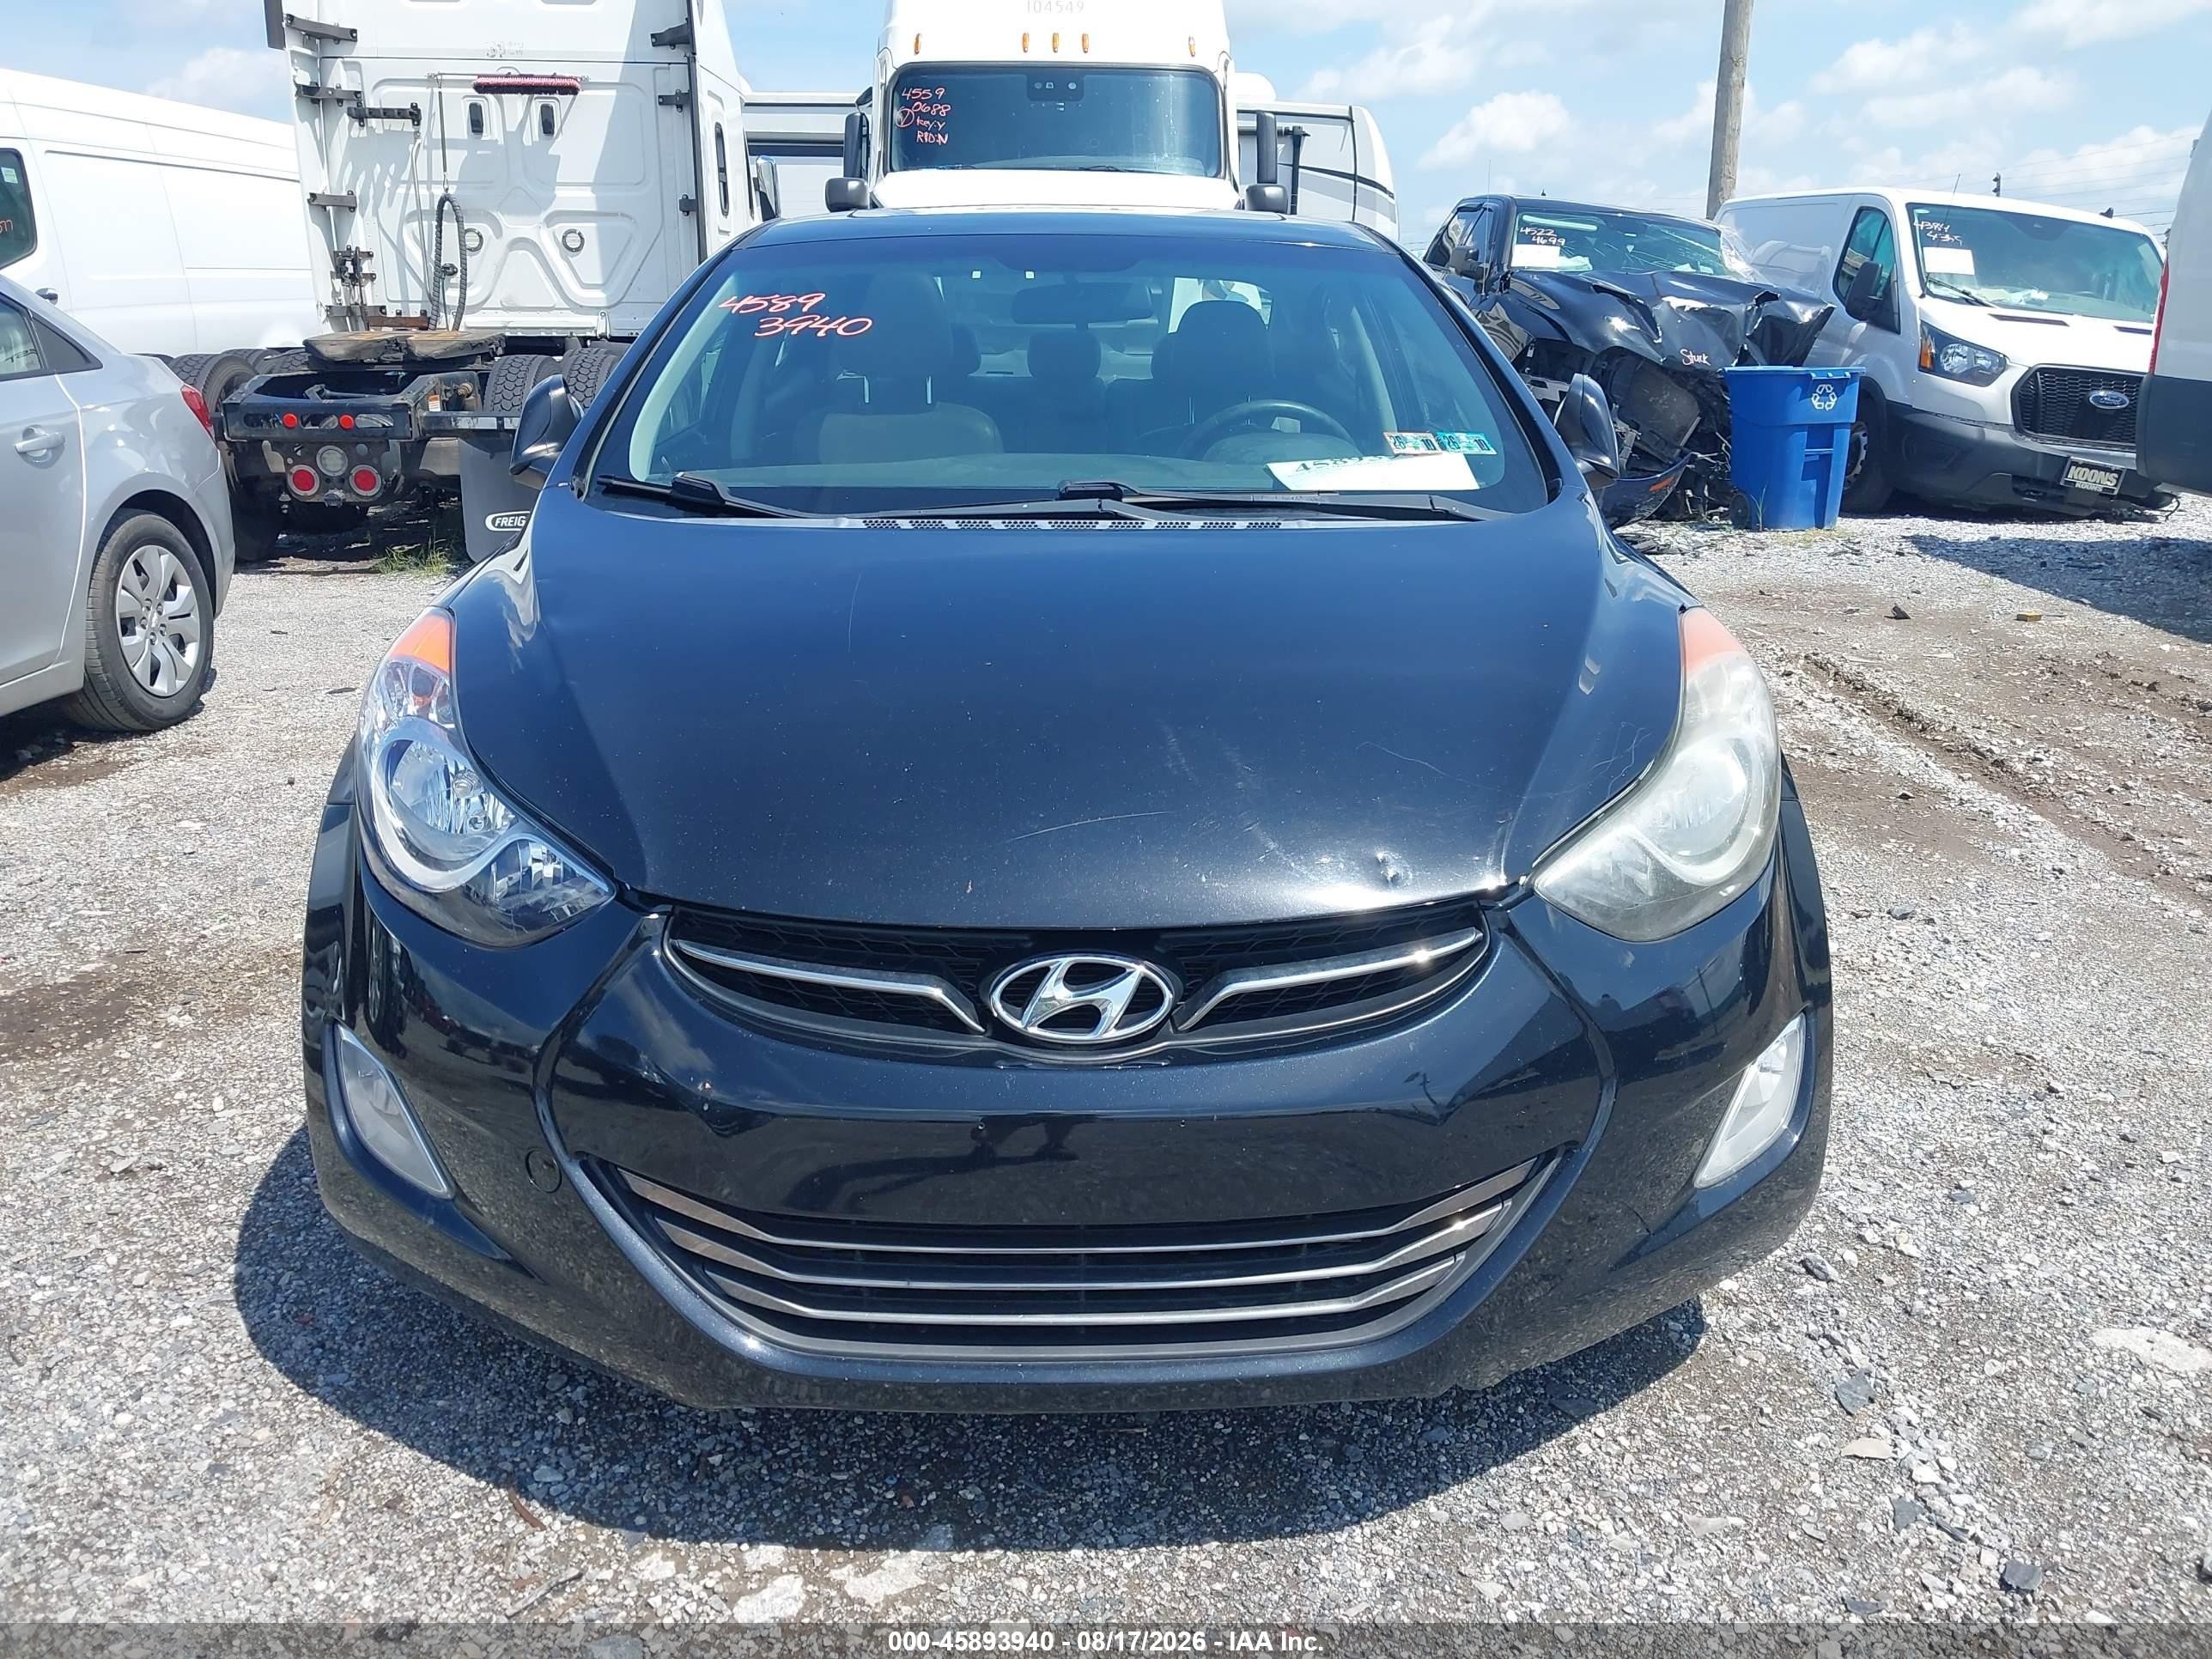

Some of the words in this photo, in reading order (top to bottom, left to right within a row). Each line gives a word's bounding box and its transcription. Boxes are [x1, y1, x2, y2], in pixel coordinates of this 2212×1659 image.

[1027, 0, 1085, 14] 104549
[901, 88, 945, 100] 4559
[912, 101, 951, 116] 0688
[1519, 227, 1558, 237] 4522
[1531, 235, 1566, 246] 4699
[718, 293, 826, 313] 4589
[754, 314, 873, 337] 3940
[2068, 465, 2119, 486] KOONS
[2075, 481, 2103, 492] KOONS
